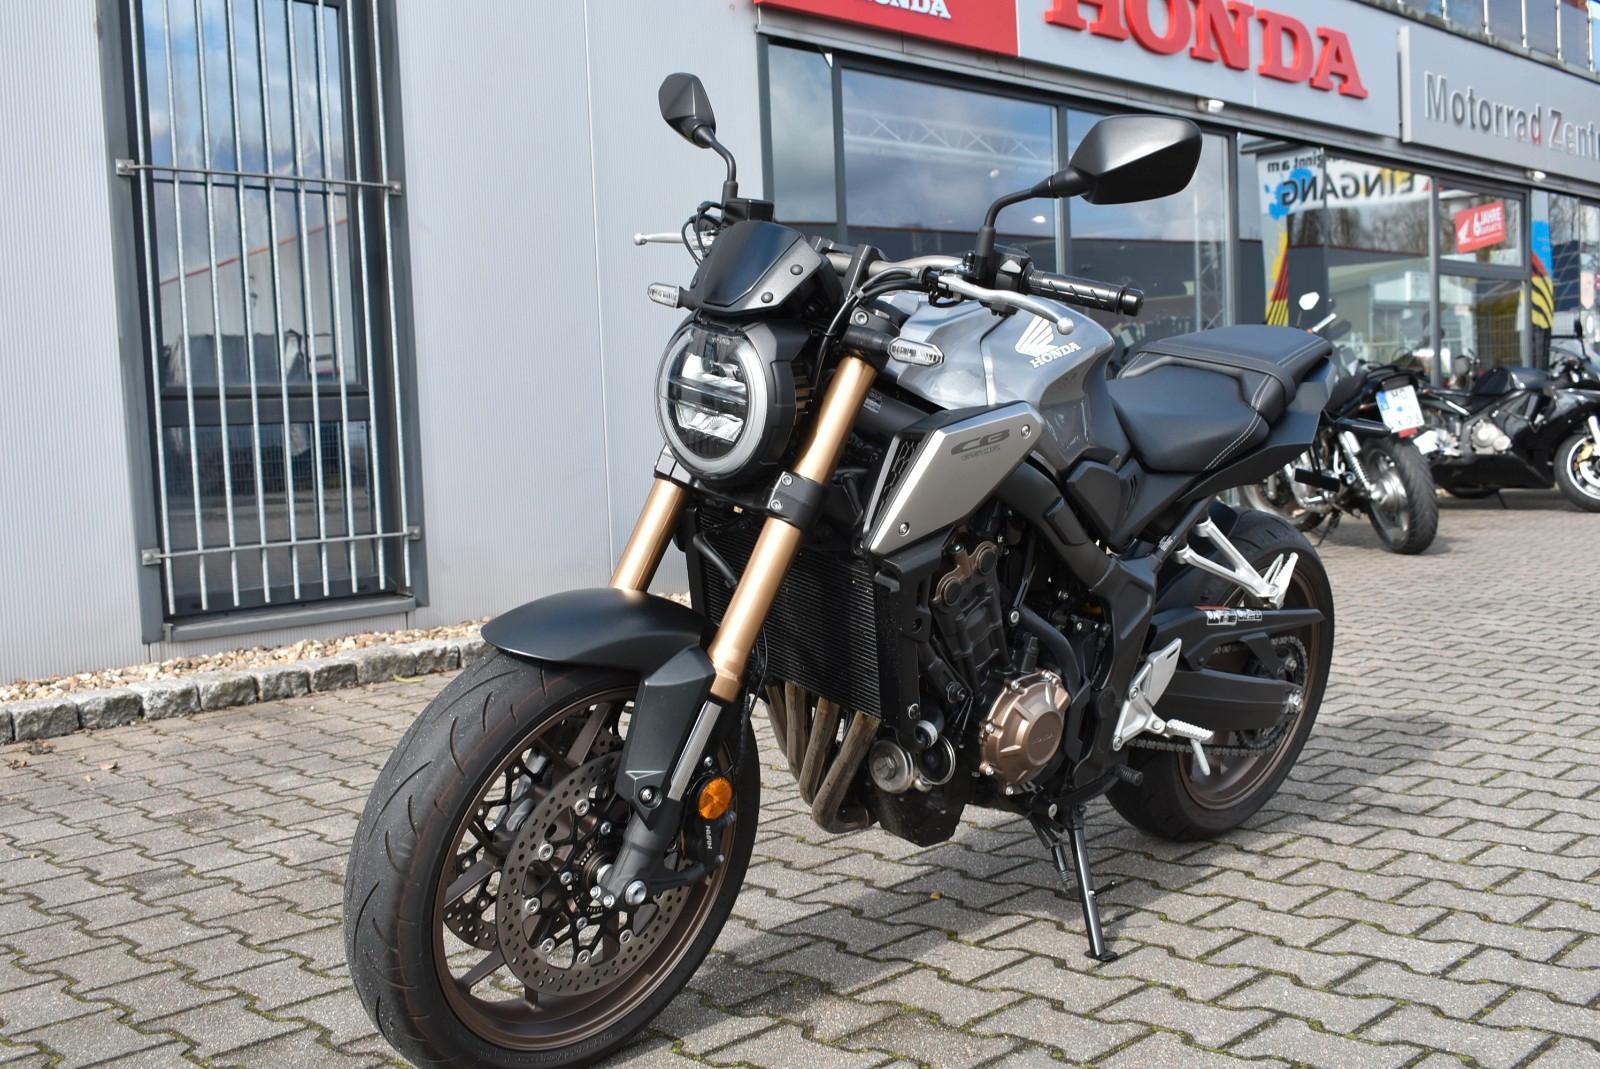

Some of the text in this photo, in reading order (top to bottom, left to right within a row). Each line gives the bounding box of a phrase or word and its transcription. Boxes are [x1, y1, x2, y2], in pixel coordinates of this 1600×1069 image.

[1424, 70, 1542, 145] Motorrad
[1028, 342, 1081, 368] HONDA
[951, 429, 1010, 455] CB
